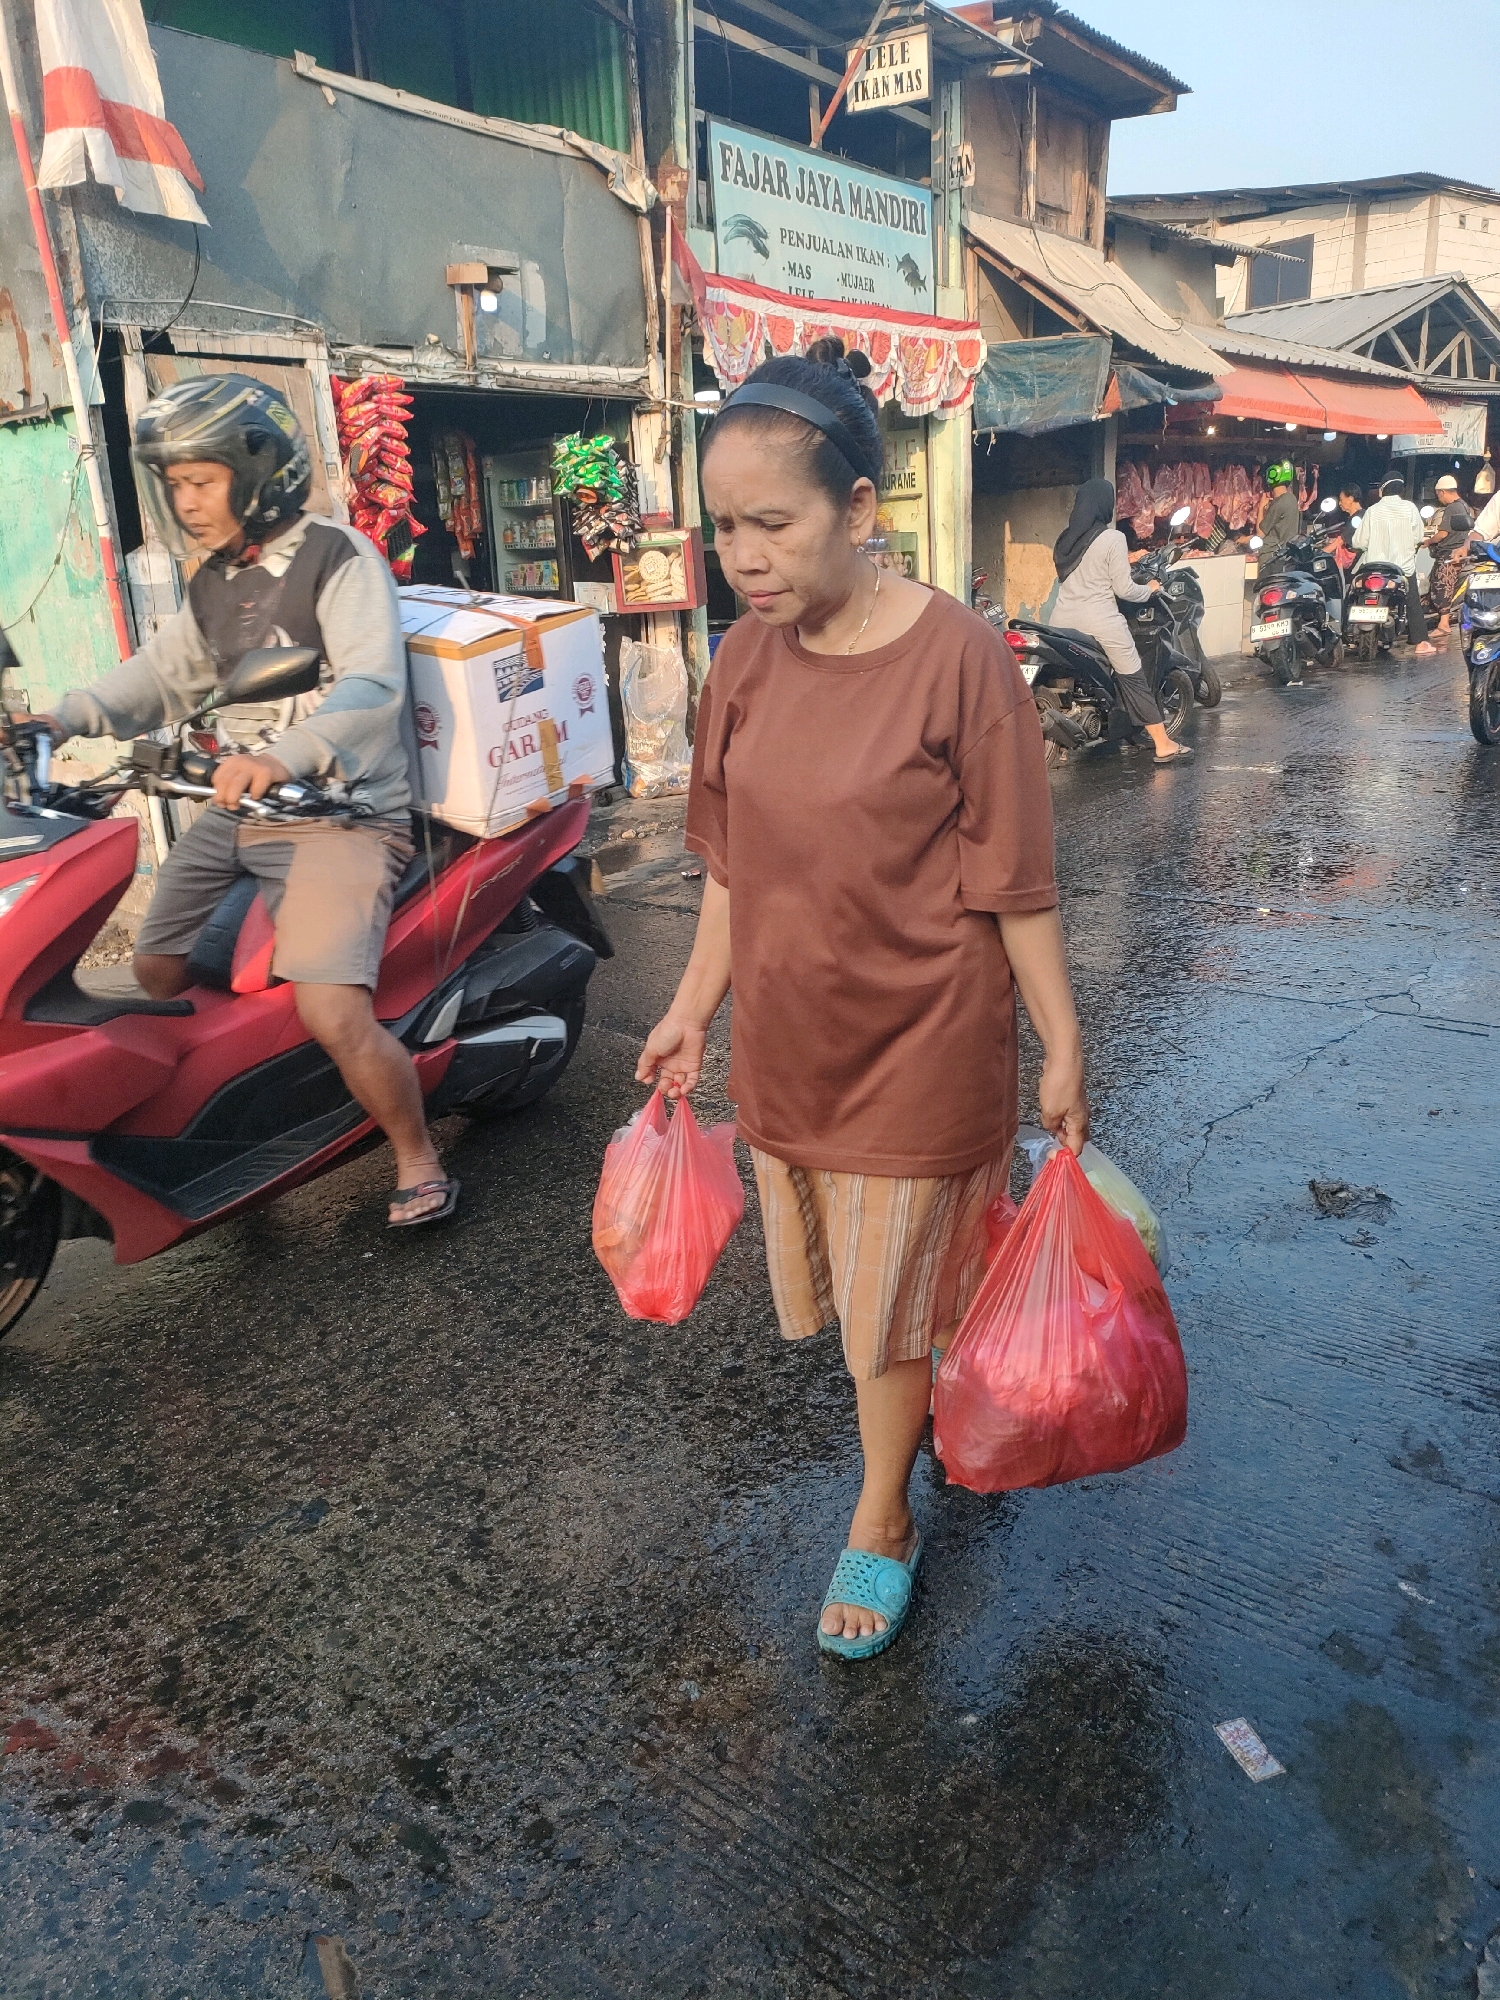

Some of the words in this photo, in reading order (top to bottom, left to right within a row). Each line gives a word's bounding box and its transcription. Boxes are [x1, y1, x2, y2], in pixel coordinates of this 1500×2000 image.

[865, 40, 910, 71] LELE
[854, 75, 890, 102] IKAN
[894, 69, 922, 95] MAS
[719, 141, 791, 200] FAJAR
[796, 167, 845, 215] JAYA
[849, 182, 927, 235] MANDIRI
[780, 227, 853, 259] PENJUALAN
[787, 260, 812, 280] MAS
[840, 272, 875, 293] MUJAER
[488, 720, 569, 768] GARM
